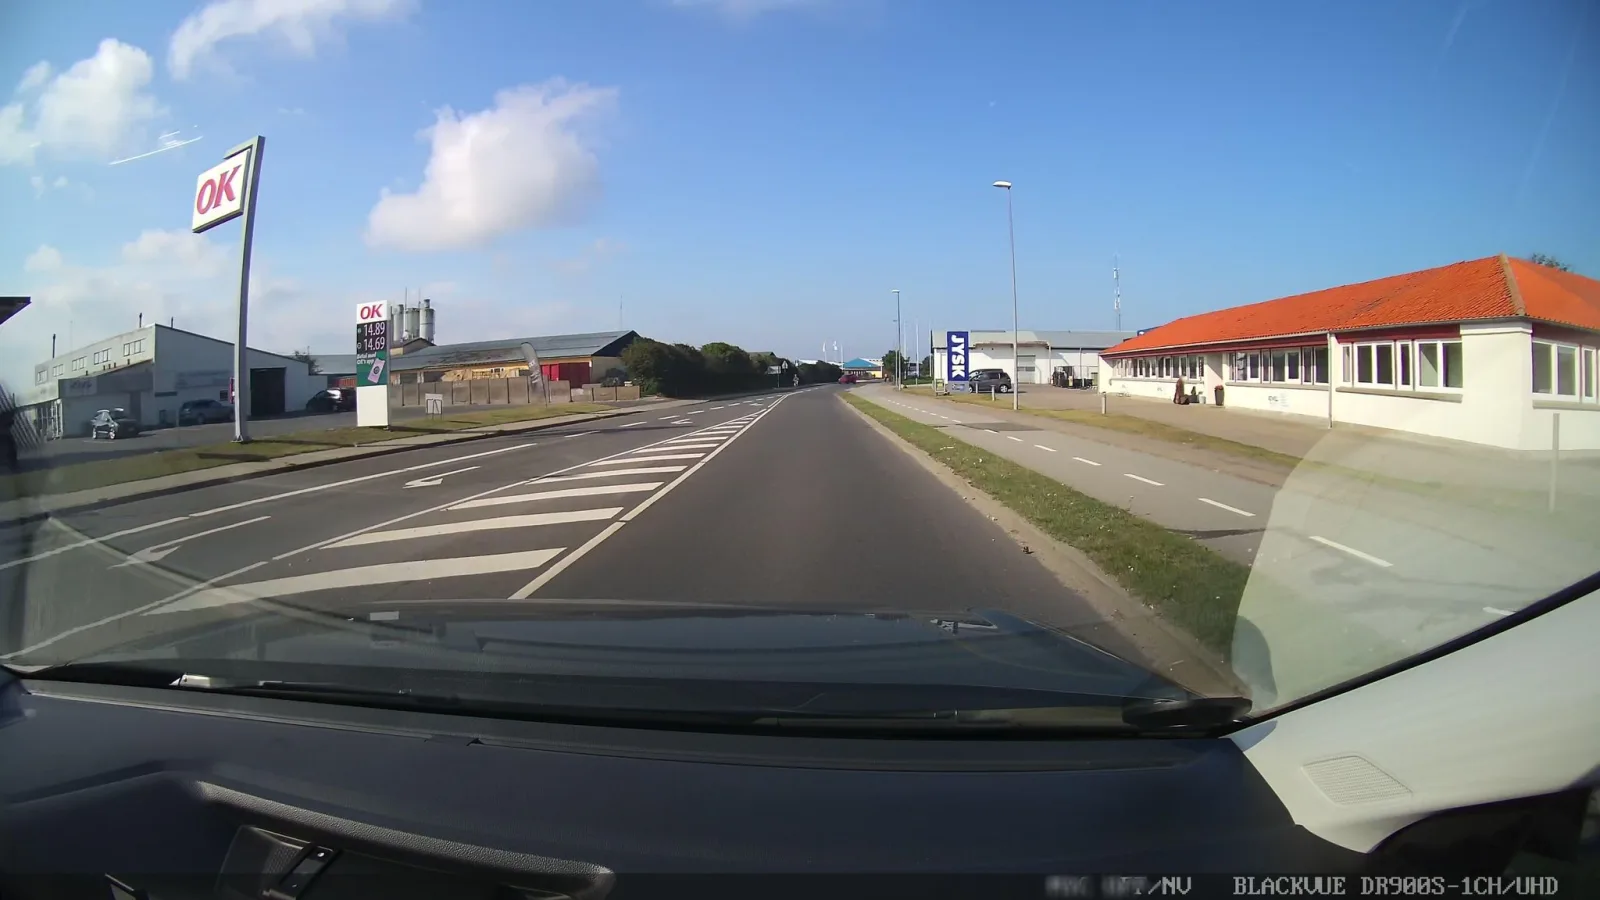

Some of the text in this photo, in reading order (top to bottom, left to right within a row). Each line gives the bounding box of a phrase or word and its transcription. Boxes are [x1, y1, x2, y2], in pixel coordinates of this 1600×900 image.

[197, 164, 242, 214] OK
[360, 304, 383, 319] OK
[364, 322, 385, 336] 14.89
[364, 337, 385, 350] 14.69
[951, 334, 965, 378] JYSK
